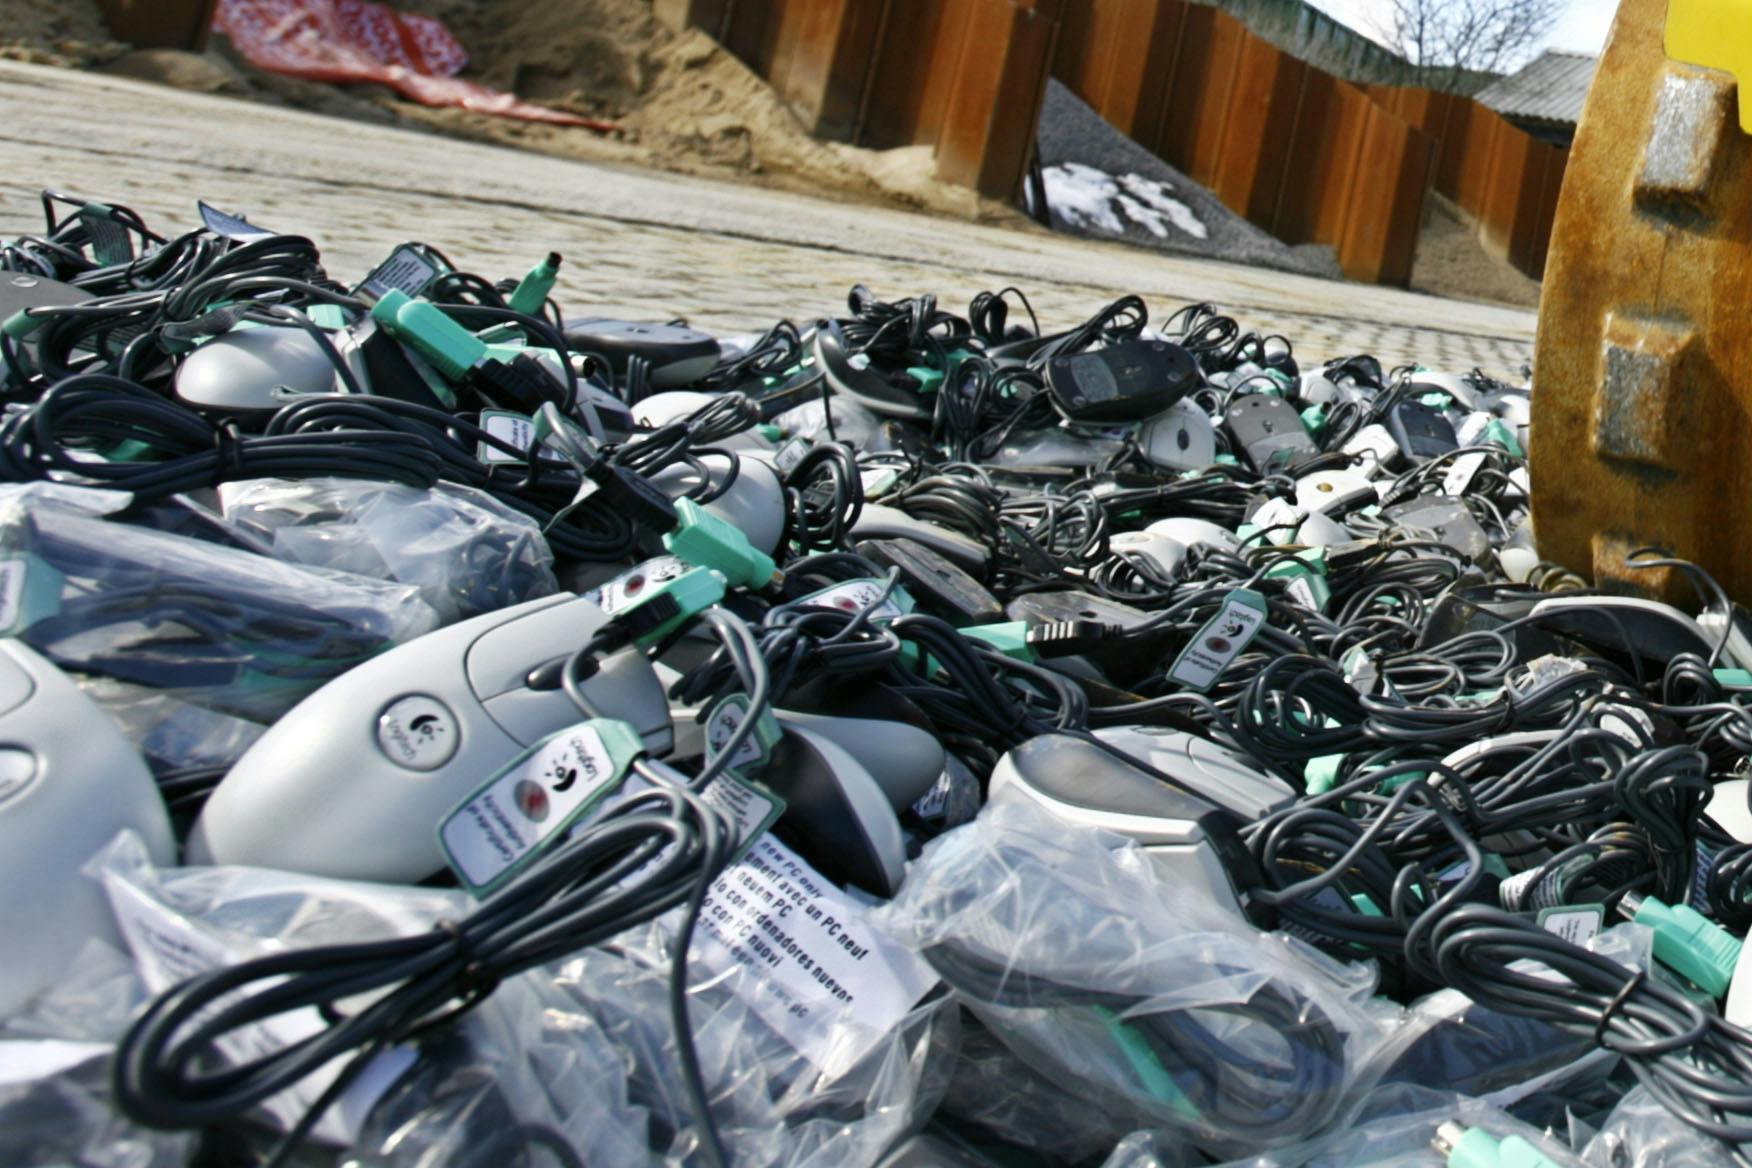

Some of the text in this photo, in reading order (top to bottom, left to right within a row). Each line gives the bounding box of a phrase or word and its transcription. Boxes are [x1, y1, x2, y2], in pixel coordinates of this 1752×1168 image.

[760, 840, 784, 863] new
[726, 889, 748, 910] con
[736, 864, 793, 919] neuem PC
[711, 902, 734, 923] con
[748, 934, 784, 969] nuovi
[779, 880, 808, 907] avec
[805, 903, 822, 922] un
[820, 914, 842, 936] PC
[837, 933, 869, 961] neuf
